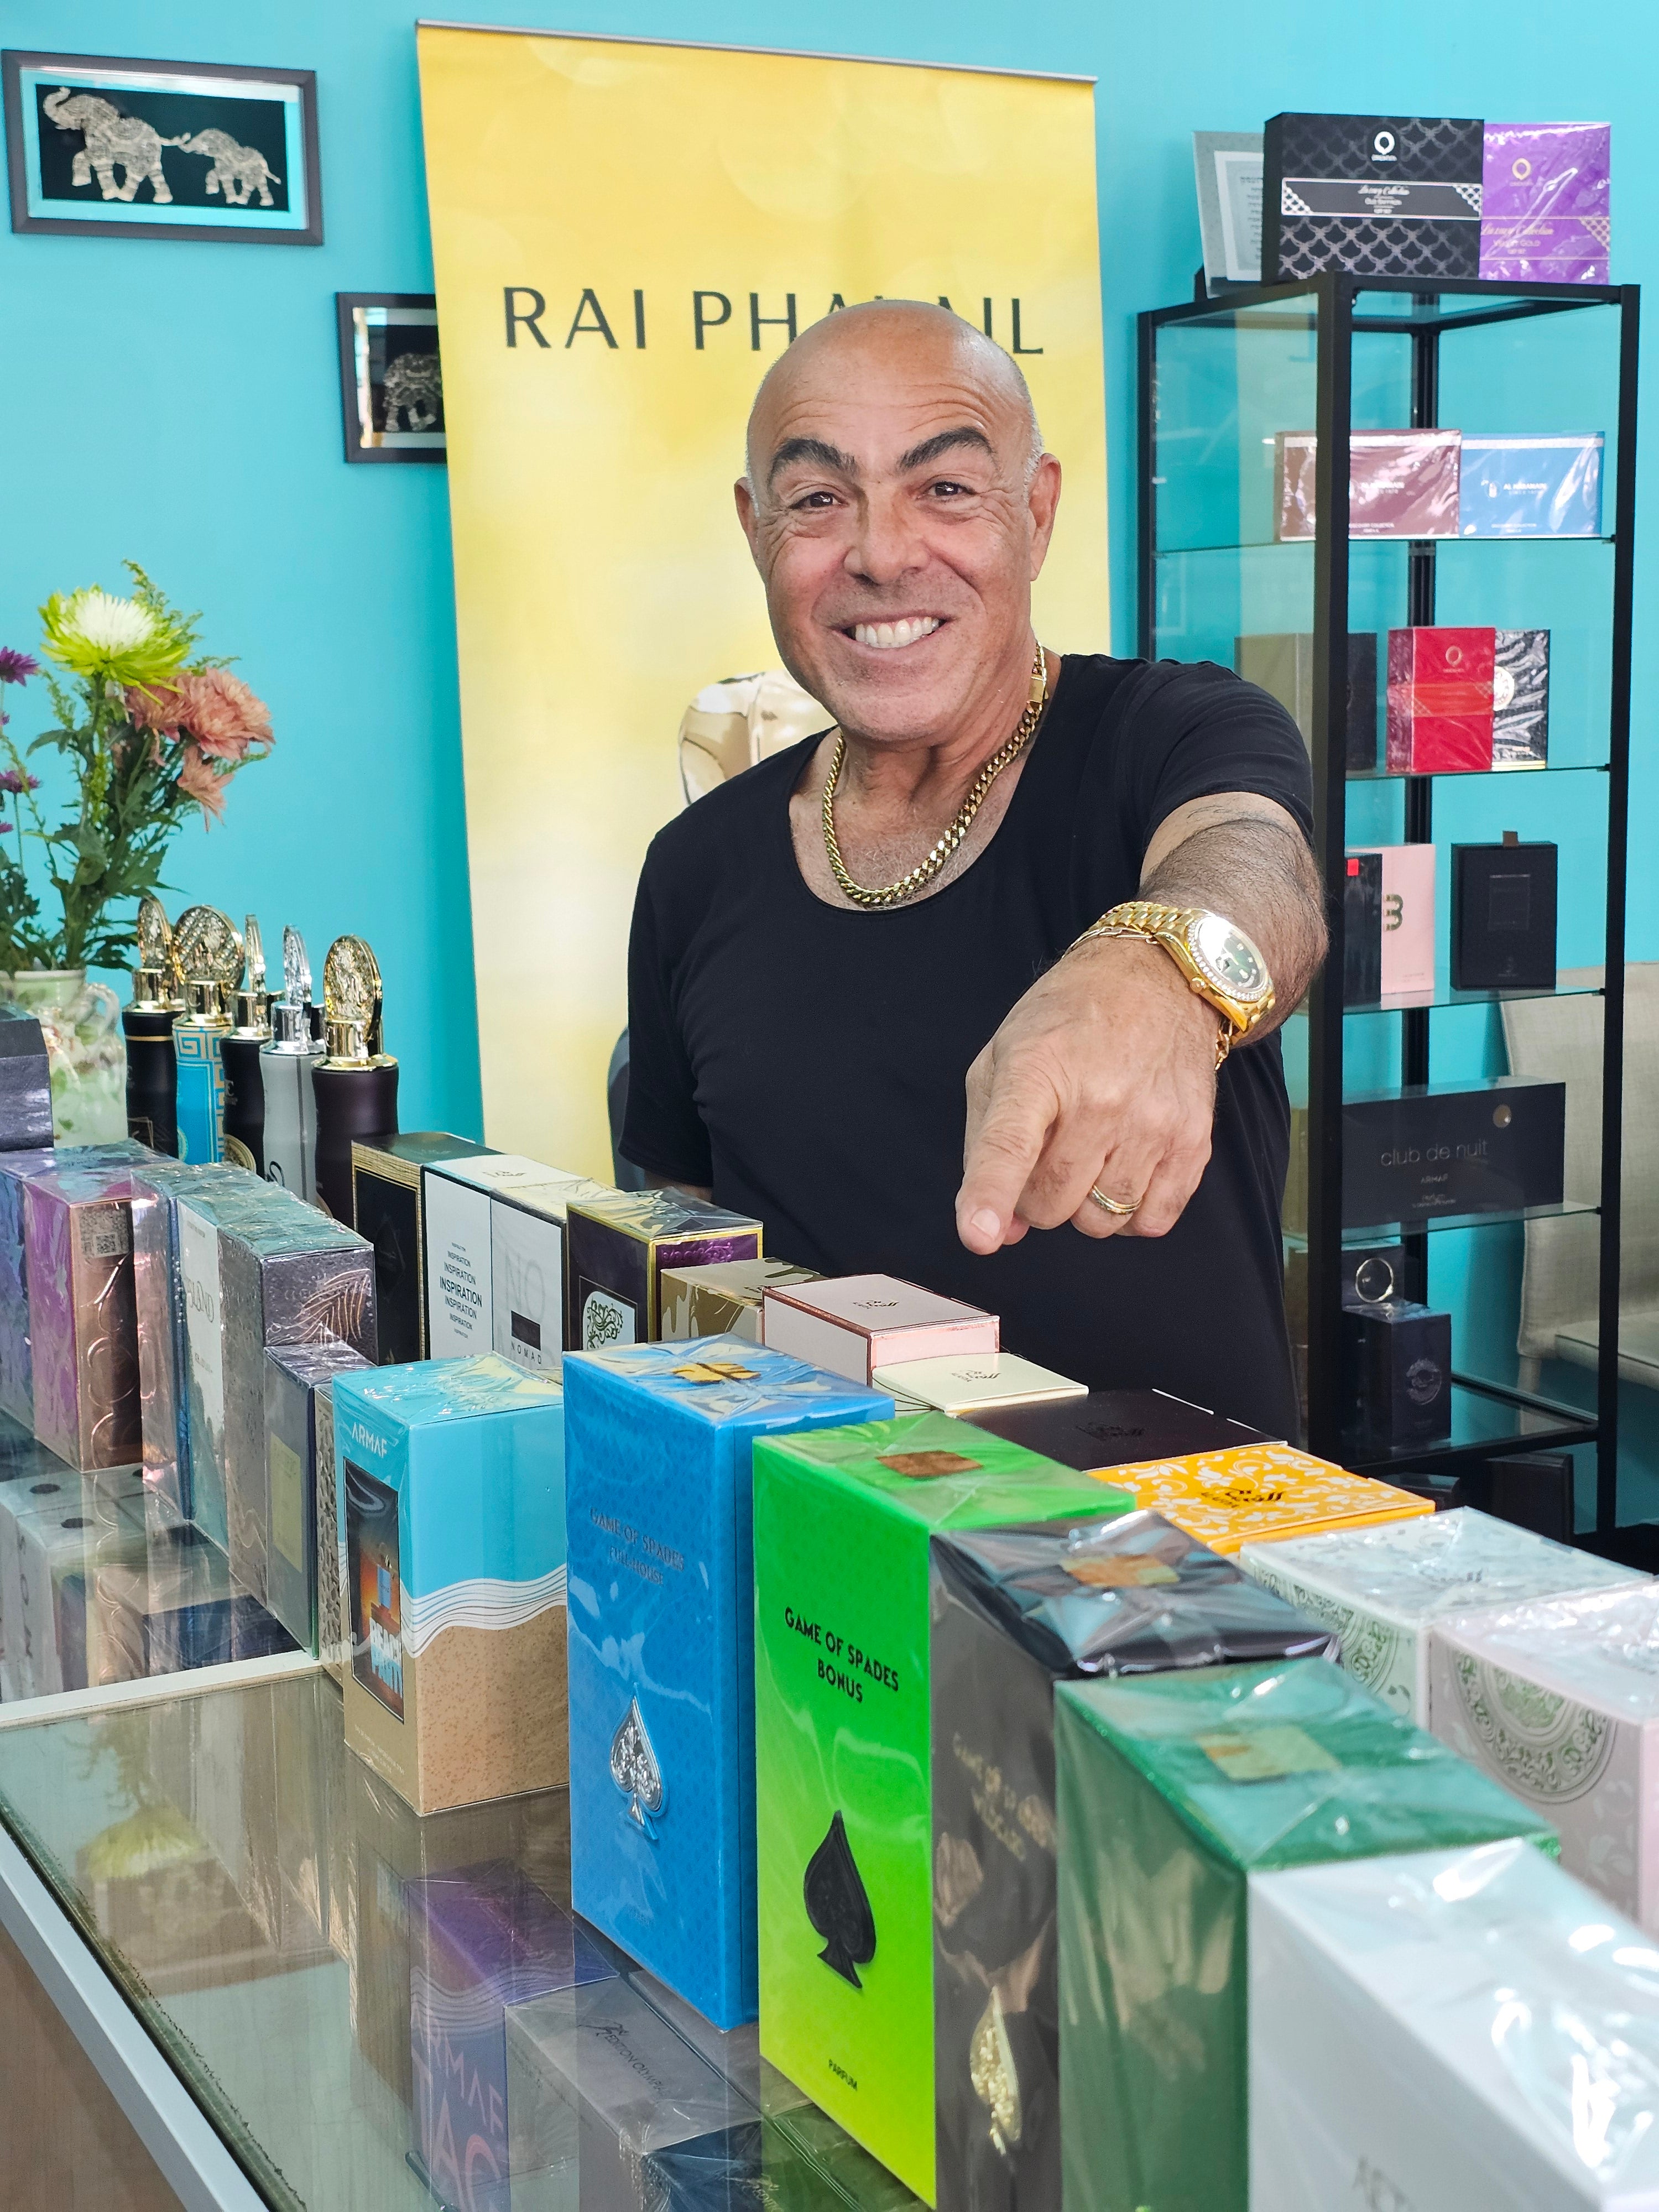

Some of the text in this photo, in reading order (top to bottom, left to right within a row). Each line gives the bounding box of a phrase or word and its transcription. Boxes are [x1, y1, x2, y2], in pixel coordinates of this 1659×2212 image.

[503, 286, 1044, 355] RAI PHIL
[1381, 1139, 1488, 1166] club de nuit
[444, 1261, 476, 1286] INSPIRATION
[440, 1275, 482, 1307] INSPIRATION
[445, 1295, 477, 1319] INSPIRATION
[511, 1340, 542, 1365] NOMAD
[352, 1422, 387, 1458] ARMAF
[643, 1535, 685, 1572] SPADES
[785, 1606, 899, 1692] GAME OF SPADES
[817, 1657, 863, 1704] BONUS
